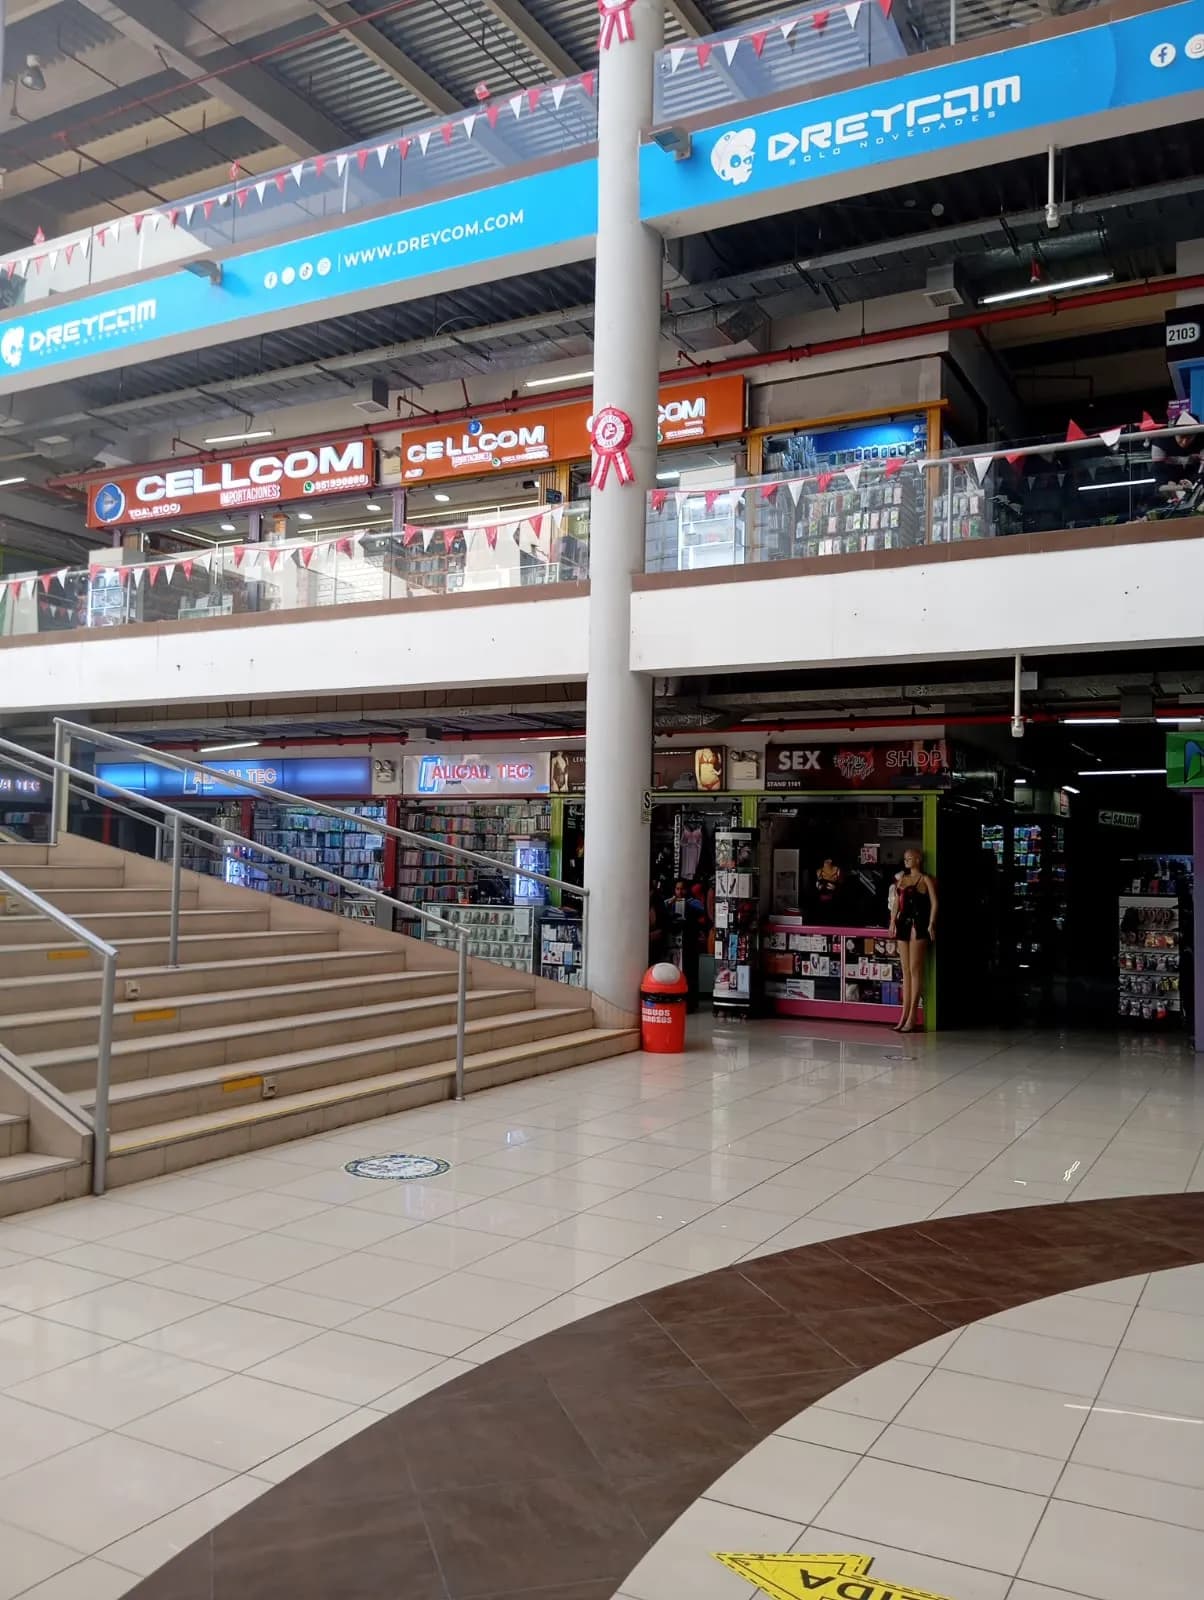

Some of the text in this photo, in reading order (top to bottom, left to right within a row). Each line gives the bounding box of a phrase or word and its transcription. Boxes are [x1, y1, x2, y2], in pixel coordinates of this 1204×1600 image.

[767, 75, 1021, 161] DREYCOM
[789, 111, 997, 167] SOLO NOVEDADES
[343, 209, 524, 269] WWW.DREYCOM.COM
[1168, 327, 1196, 342] 2103
[407, 425, 545, 462] CELLCOM
[135, 441, 364, 501] CELLCOM
[246, 763, 278, 785] TEC
[497, 762, 533, 779] TEC
[778, 751, 822, 771] SEX
[885, 750, 944, 767] SHOP
[1113, 814, 1138, 826] SALIDA
